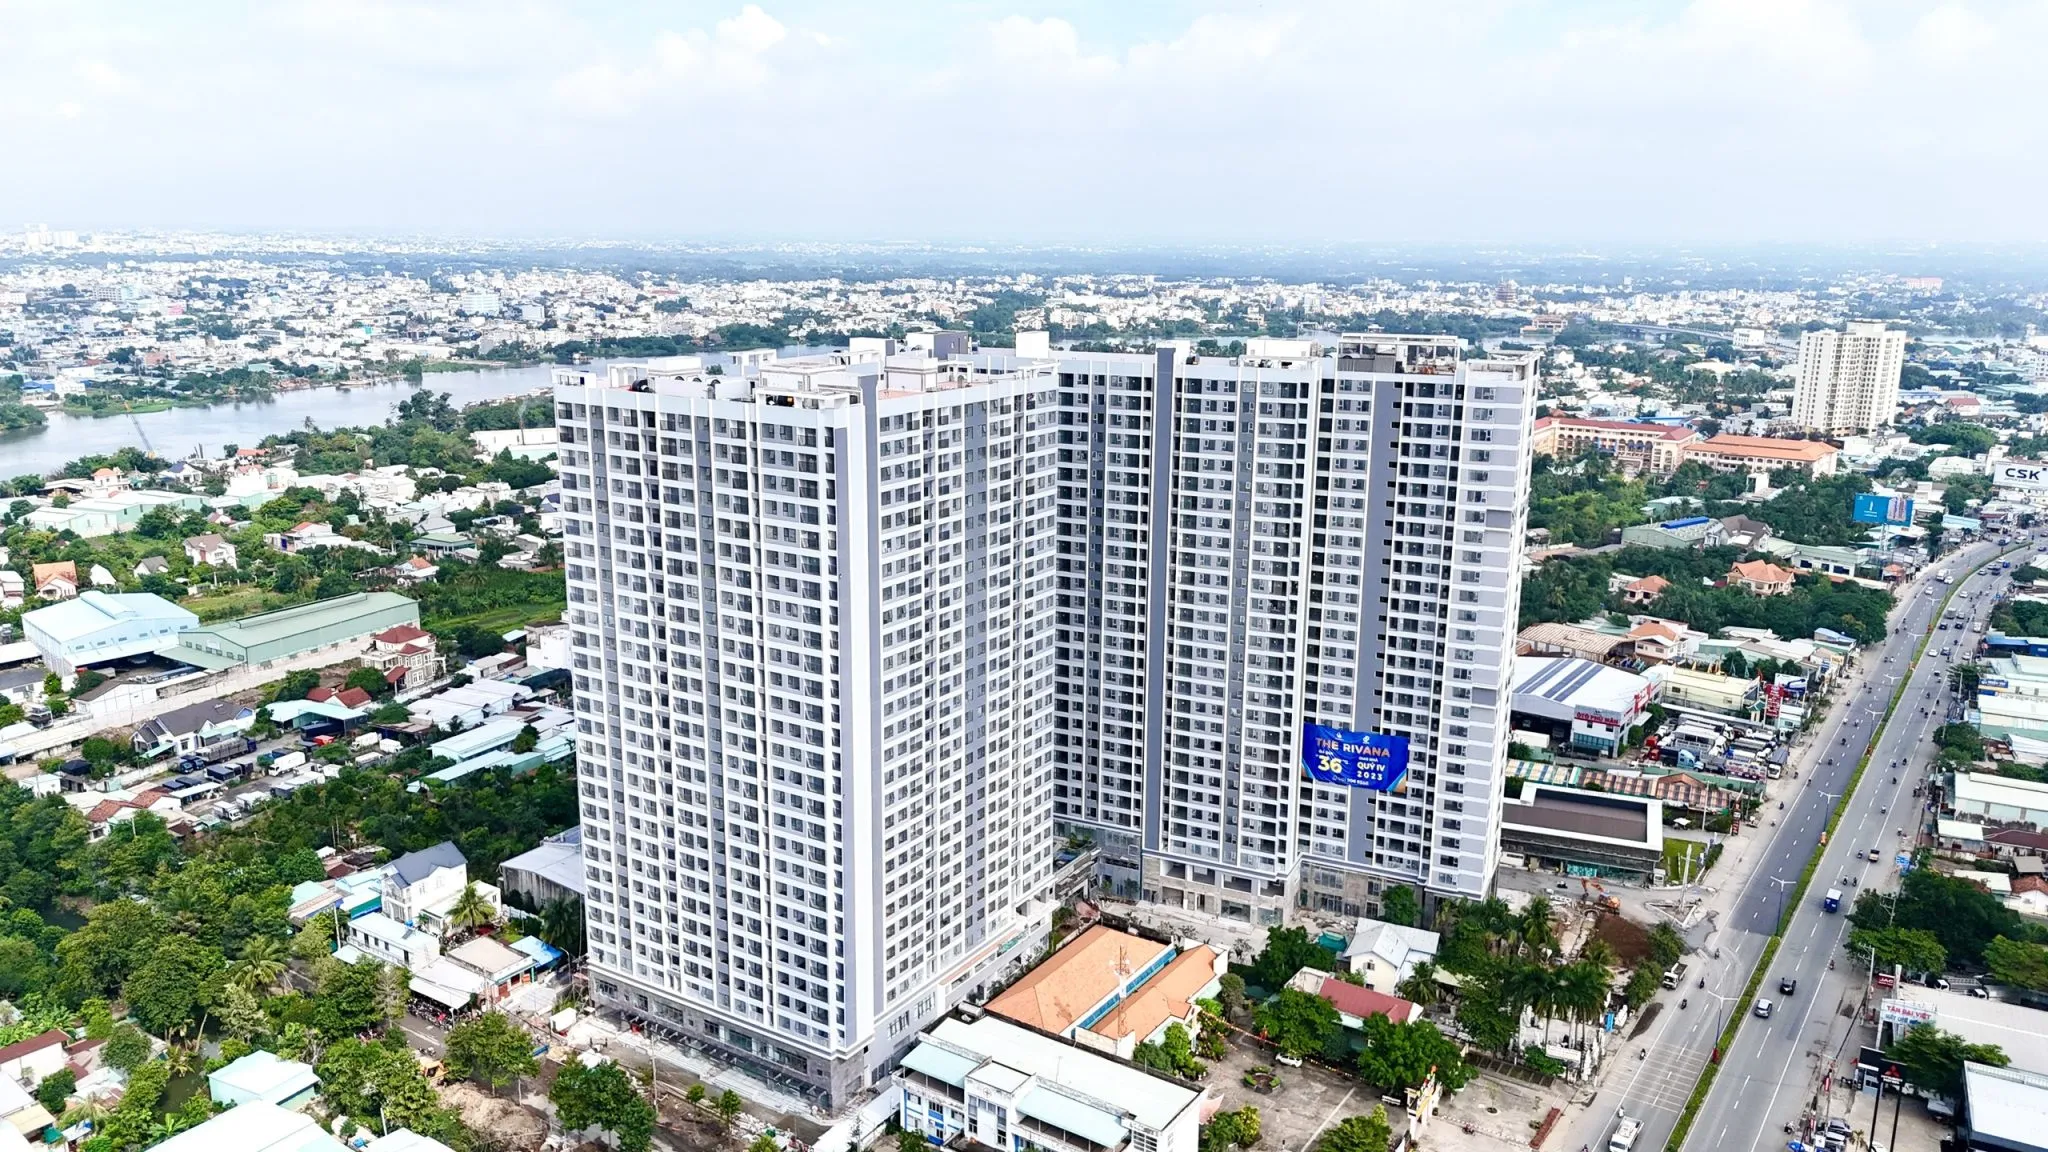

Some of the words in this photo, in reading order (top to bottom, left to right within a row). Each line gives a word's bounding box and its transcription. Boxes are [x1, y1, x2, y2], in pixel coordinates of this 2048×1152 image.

[2005, 468, 2040, 480] CSK
[1315, 737, 1339, 750] THE
[1343, 743, 1390, 758] RIVANA
[1318, 755, 1342, 774] 36
[1377, 764, 1386, 772] IV
[1357, 770, 1383, 781] 2023
